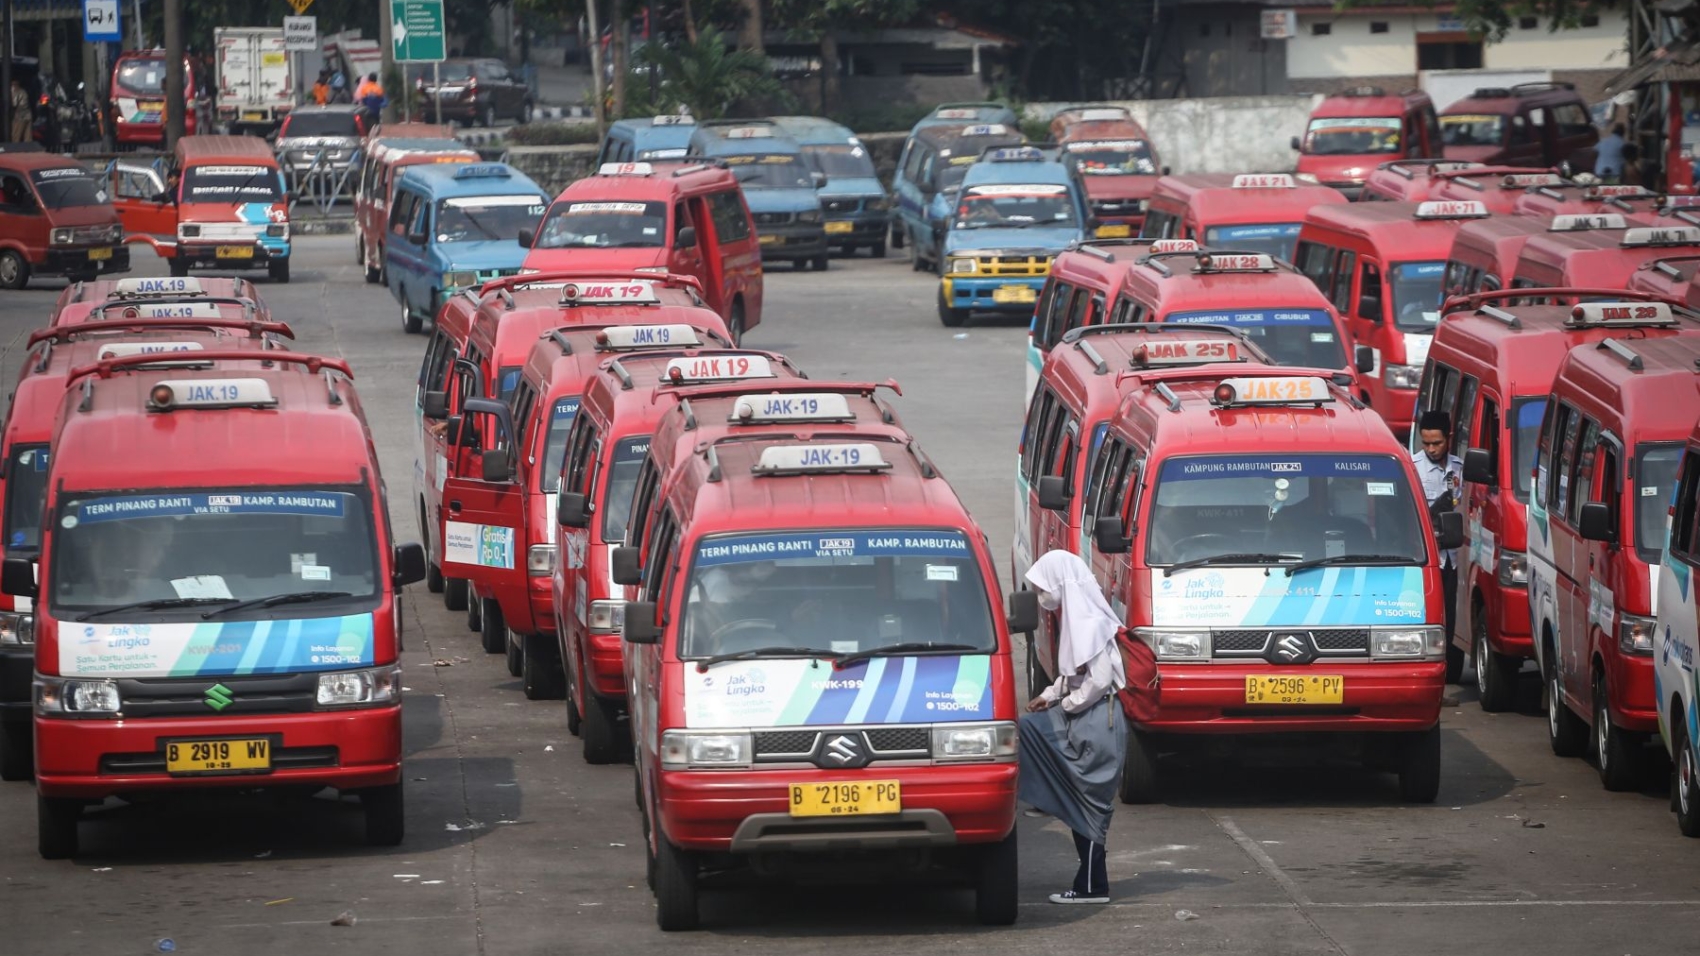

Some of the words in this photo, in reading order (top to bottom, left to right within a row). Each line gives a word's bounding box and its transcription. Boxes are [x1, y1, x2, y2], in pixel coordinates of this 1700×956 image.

[617, 162, 636, 173] 19
[1239, 177, 1268, 187] JAK
[1271, 177, 1287, 187] 71
[527, 205, 546, 216] 112
[1158, 241, 1177, 251] JAK
[1213, 256, 1237, 269] JAK
[1240, 256, 1260, 268] 28
[580, 286, 614, 298] JAK
[619, 285, 644, 298] 19
[1188, 315, 1230, 324] RAMBUTAN
[1601, 308, 1632, 321] JAK
[1635, 307, 1658, 319] 28
[632, 328, 655, 344] JAK
[656, 328, 670, 343] 19
[1148, 343, 1188, 359] JAK
[1195, 342, 1225, 357] 25
[689, 360, 721, 378] JAK
[726, 358, 749, 376] 19
[763, 399, 818, 415] JAK-19
[800, 448, 860, 466] JAK-19
[1184, 463, 1225, 474] KAMPUNG
[1227, 462, 1271, 472] RAMBUTAN
[1334, 462, 1371, 472] KALISARI
[85, 503, 114, 515] TERM
[115, 500, 157, 513] PINANG
[159, 497, 191, 508] RANTI
[243, 496, 276, 506] KAMP.
[278, 497, 336, 509] RAMBUTAN
[193, 506, 208, 514] VIA
[482, 528, 506, 544] Gratis
[483, 545, 493, 562] Rp
[700, 546, 729, 558] TERM
[732, 543, 775, 555] PINANG
[777, 540, 812, 551] RANTI
[868, 538, 902, 548] KAMP.
[904, 538, 966, 549] RAMBUTAN
[815, 549, 830, 557] VIA
[1185, 578, 1206, 589] Jak
[1185, 588, 1224, 600] Lingko
[1384, 608, 1422, 618] 1500-102
[108, 625, 129, 636] Jak
[108, 636, 150, 650] Lingko
[124, 653, 149, 661] untuk
[321, 655, 362, 664] 1500-102
[77, 664, 107, 673] Semua
[726, 674, 746, 685] Jak
[811, 679, 864, 690] KWK-199
[1248, 677, 1257, 694] B
[1270, 677, 1305, 694] 2596
[1322, 677, 1340, 694] PV
[726, 685, 765, 697] Lingko
[936, 701, 980, 712] 1500-102
[168, 744, 179, 762] B
[190, 742, 230, 761] 2919
[246, 741, 267, 759] WV
[793, 786, 803, 805] B
[820, 785, 860, 804] 2196
[876, 783, 897, 803] PG
